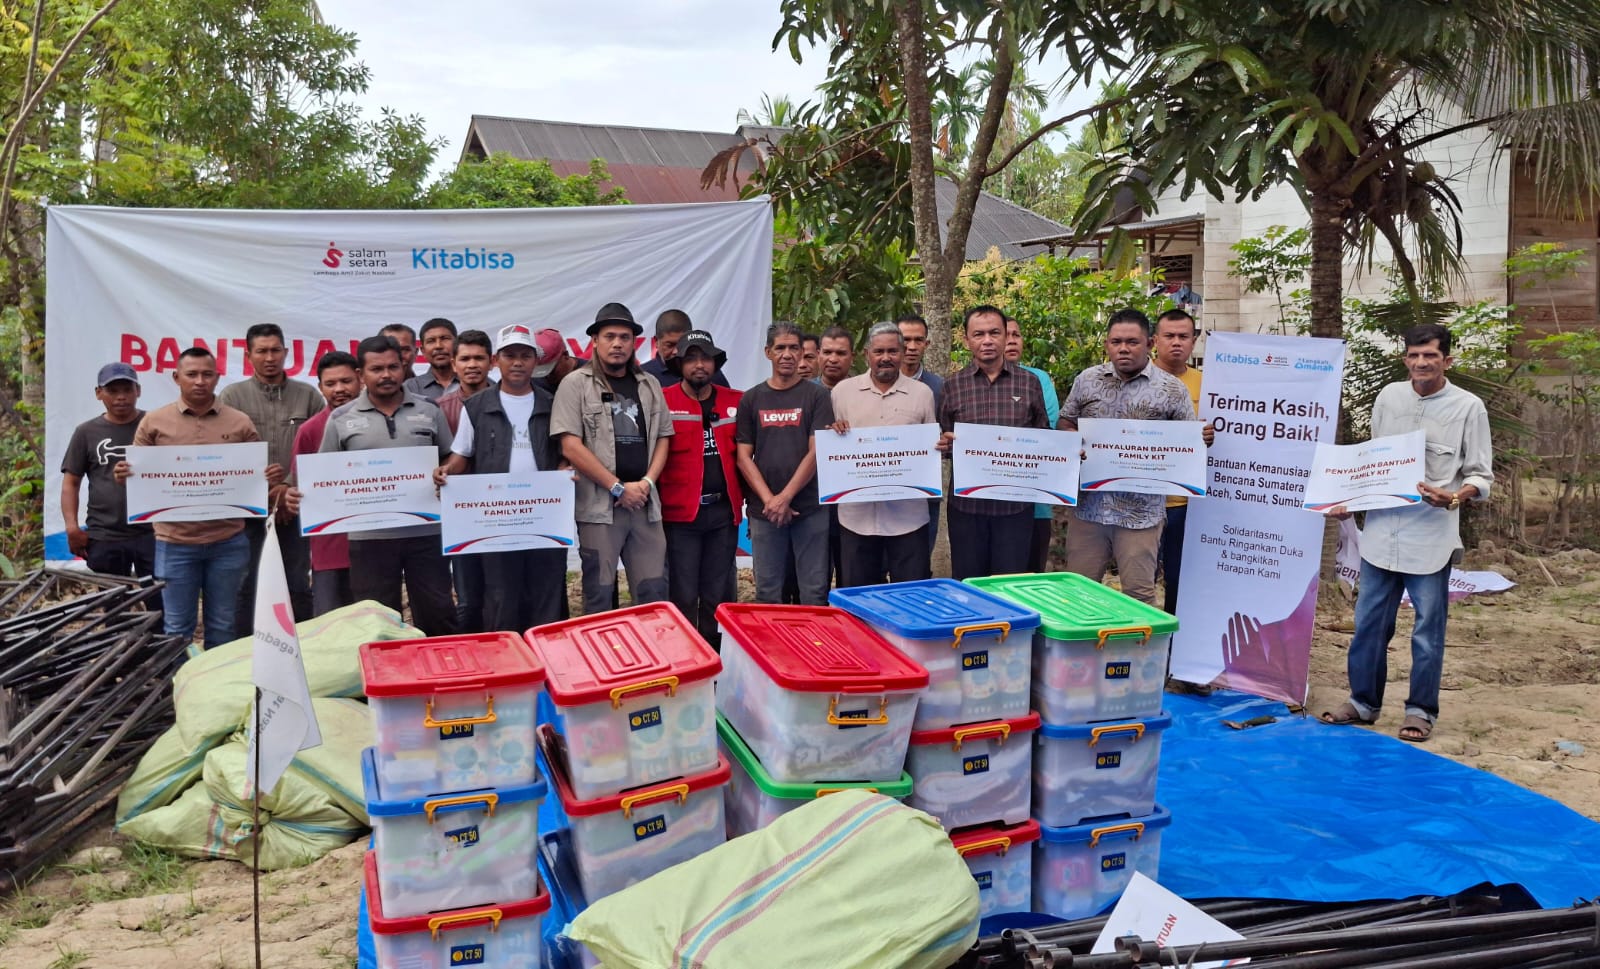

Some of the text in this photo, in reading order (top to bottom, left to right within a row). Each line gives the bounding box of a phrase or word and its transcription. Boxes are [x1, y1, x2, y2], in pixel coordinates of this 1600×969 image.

[349, 247, 386, 259] salam
[411, 247, 515, 270] Kitabisa
[349, 259, 388, 268] setara
[1215, 352, 1260, 366] Kitabisa
[1208, 392, 1329, 422] Terima Kasih,
[1212, 417, 1320, 442] Orang Baik!
[1091, 443, 1194, 454] PENYALURAN BANTUAN
[828, 449, 928, 461] PENYALURAN BANTUAN
[965, 449, 1067, 463] PENYALURAN BANTUAN
[1118, 452, 1149, 460] FAMILY
[855, 460, 887, 468] FAMILY
[991, 460, 1024, 468] FAMILY
[1207, 456, 1246, 470] Bantuan
[141, 469, 254, 479] PENYALURAN BANTUAN
[209, 478, 225, 486] KIT
[313, 473, 425, 489] PENYALURAN BANTUAN
[1214, 472, 1305, 493] Bencana Sumatera
[344, 484, 397, 495] FAMILY KIT
[454, 497, 561, 509] PENYALURAN BANTUAN
[1205, 486, 1304, 509] Aceh, Sumut, Sumba
[484, 508, 517, 517] FAMILY
[1222, 524, 1284, 542] Solidaritasmu
[1200, 534, 1304, 558] Bantu Ringankan Duka
[1221, 550, 1279, 566] & bangkitkan
[1217, 561, 1281, 580] Harapan Kami
[1450, 579, 1476, 591] atera
[255, 630, 294, 655] mbaga
[973, 656, 980, 665] CT
[1116, 666, 1123, 674] CT
[642, 711, 659, 723] CT 50
[454, 723, 463, 733] CT
[974, 760, 981, 769] CT
[647, 820, 663, 832] CT 50
[460, 830, 477, 841] CT 50
[1157, 914, 1177, 950] NTUAN
[464, 949, 482, 960] CT 50
